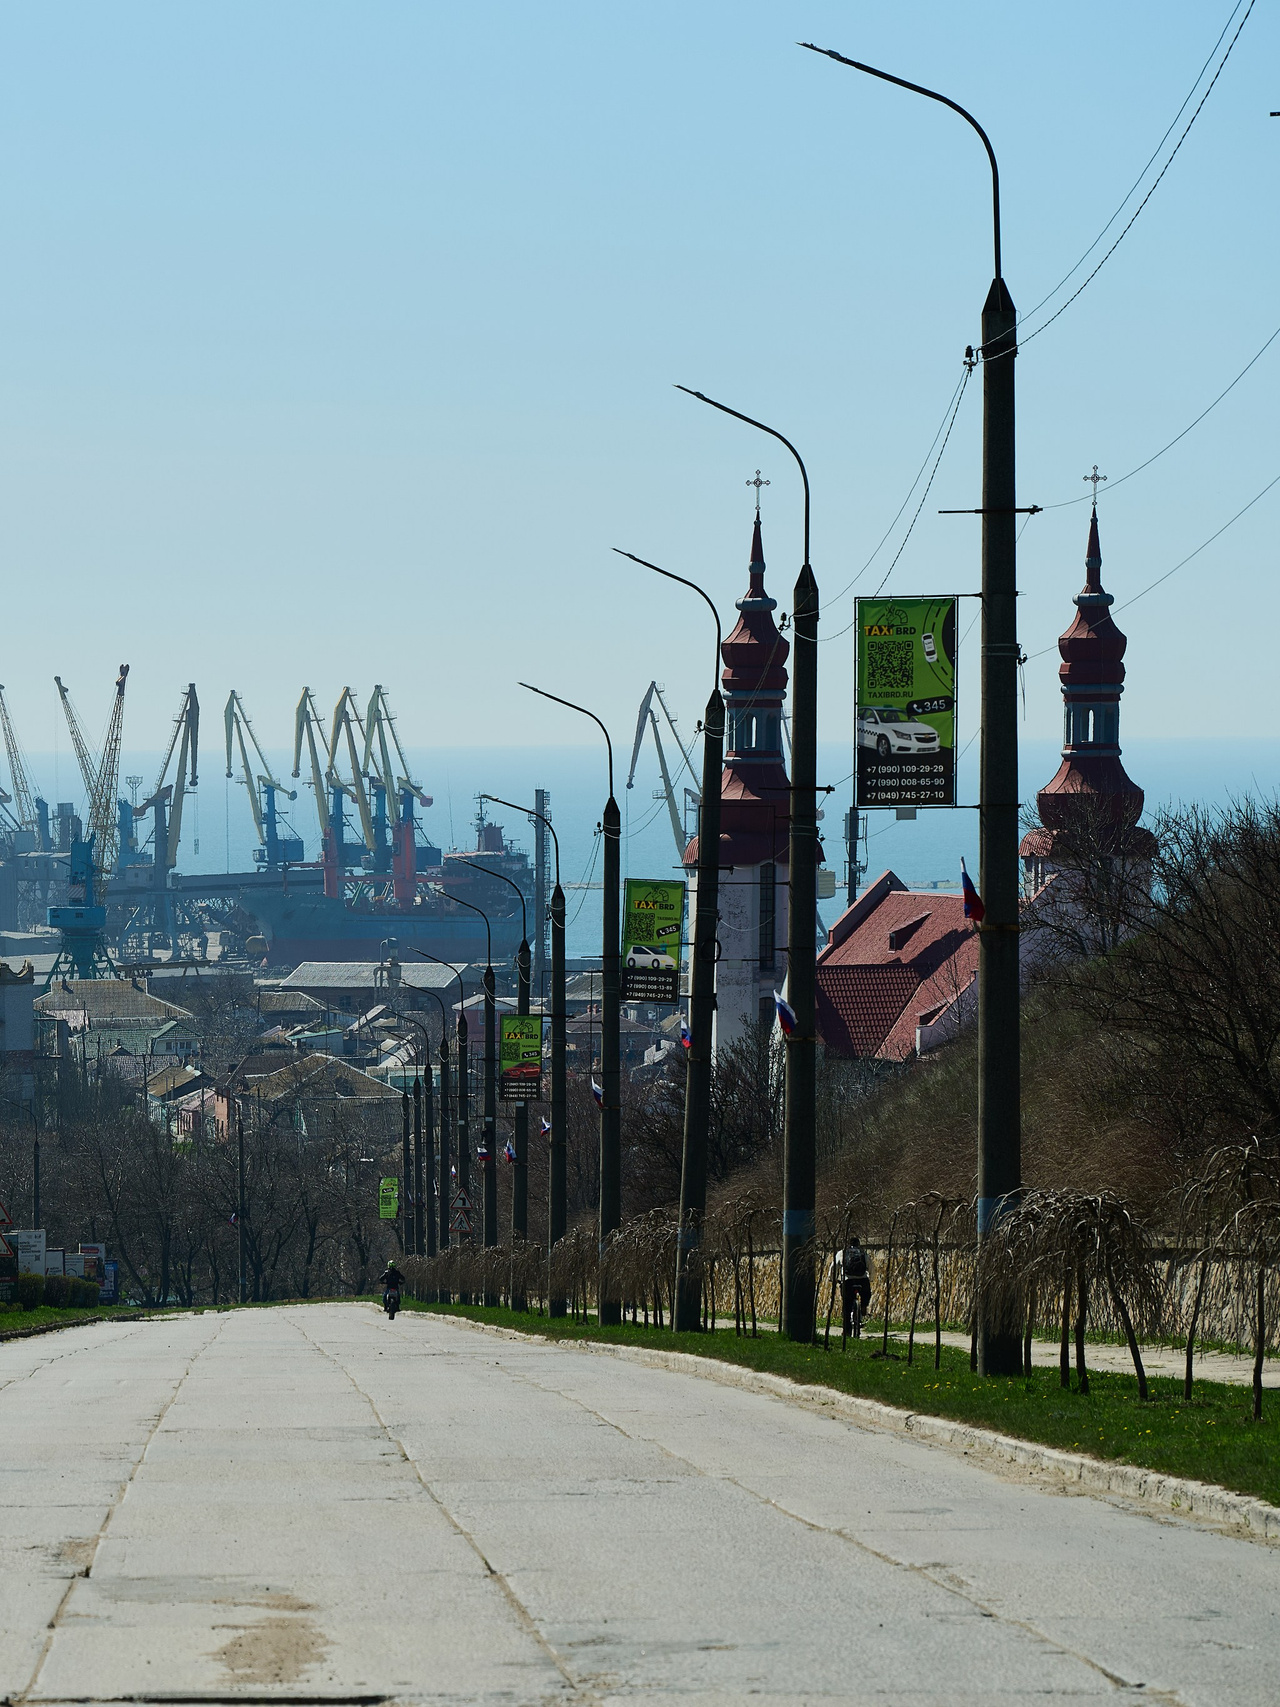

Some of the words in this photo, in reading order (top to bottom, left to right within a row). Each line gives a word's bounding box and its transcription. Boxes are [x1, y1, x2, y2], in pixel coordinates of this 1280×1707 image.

[924, 699, 946, 712] 345
[866, 766, 876, 774] +7
[878, 765, 900, 774] (990)
[902, 764, 944, 772] 109-29-29
[878, 778, 900, 786] (990)
[901, 778, 945, 786] 008-65-90
[866, 792, 876, 800] +7
[878, 792, 899, 800] (949)
[901, 791, 944, 799] 745-27-10
[665, 926, 677, 934] 345
